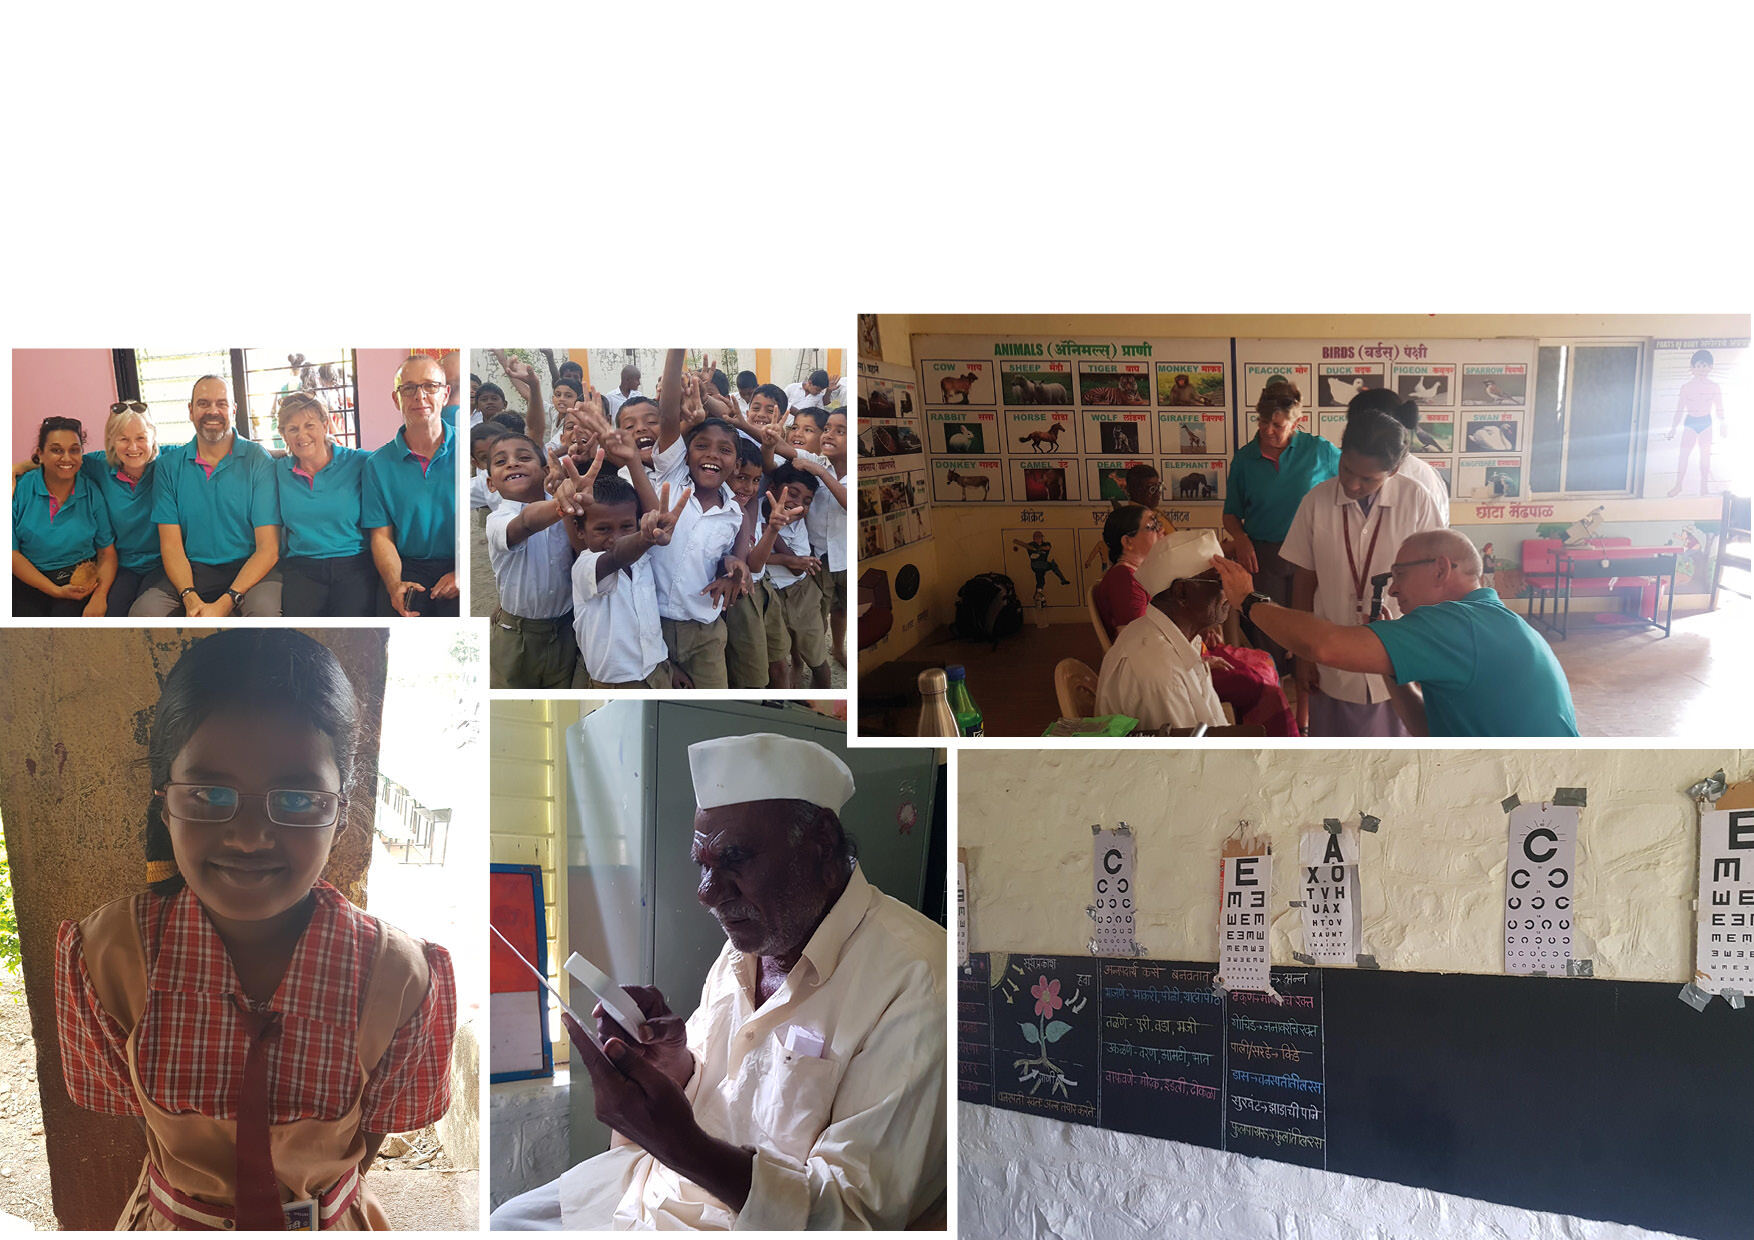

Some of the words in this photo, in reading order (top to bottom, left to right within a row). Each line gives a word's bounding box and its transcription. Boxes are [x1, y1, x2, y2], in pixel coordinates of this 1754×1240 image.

[994, 342, 1044, 357] ANIMALS
[1322, 346, 1354, 359] BIRDS
[933, 363, 956, 372] COW
[1009, 364, 1041, 372] SHEEP
[1088, 364, 1118, 372] TIGER
[1158, 364, 1199, 374] MONKEY
[1393, 366, 1428, 374] PIGEON
[1466, 367, 1503, 375] SPARROW
[930, 413, 967, 422] RABBIT
[1013, 413, 1047, 422] HORSE
[1091, 414, 1118, 422] WOLF
[1160, 414, 1199, 422] GIRAFFE
[1473, 414, 1500, 422] SWAN
[935, 460, 977, 470] DONKEY
[1020, 461, 1052, 469] CAMEL
[1097, 461, 1122, 469] DEAR
[1164, 460, 1209, 469] ELEPHANT
[1323, 834, 1344, 863] A
[1236, 858, 1258, 886] E
[1308, 866, 1320, 884] X
[1141, 961, 1166, 978] कसे
[1076, 974, 1092, 986] हवा
[1231, 1069, 1250, 1082] डास
